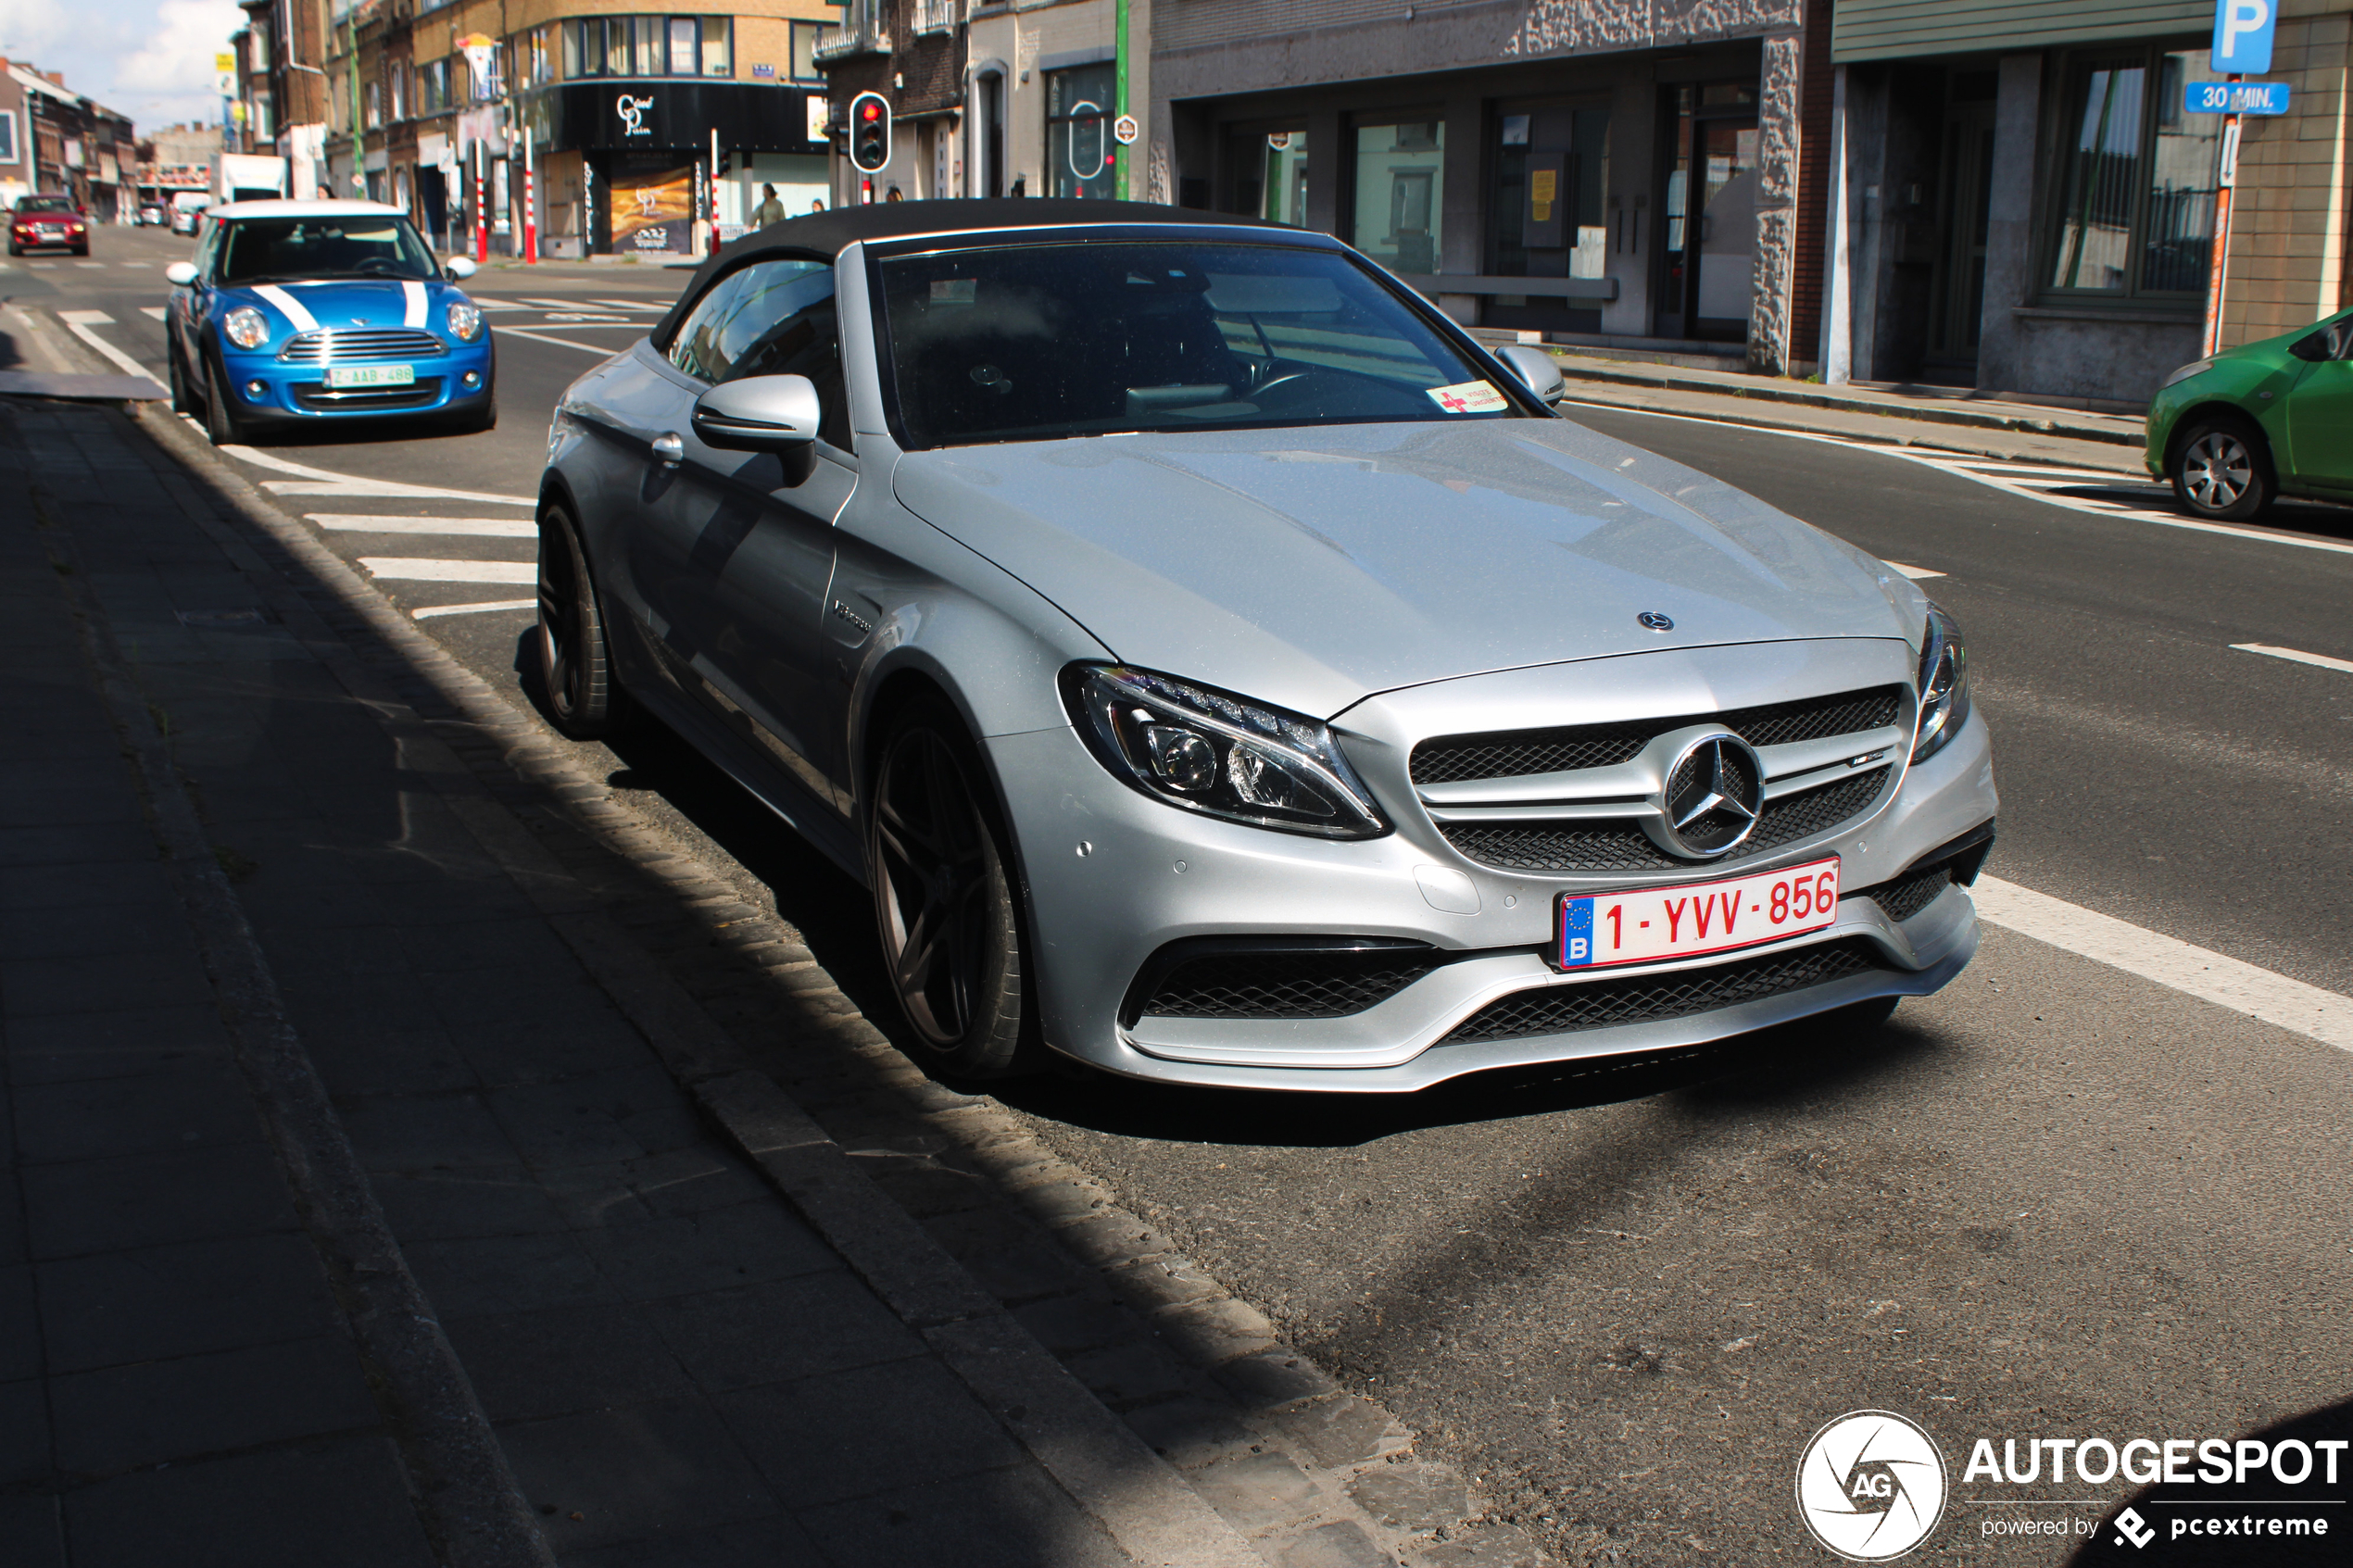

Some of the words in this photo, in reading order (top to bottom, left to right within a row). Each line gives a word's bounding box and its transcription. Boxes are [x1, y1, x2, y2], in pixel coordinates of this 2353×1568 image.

[2221, 0, 2269, 58] P
[2202, 86, 2228, 107] 30
[2233, 87, 2274, 108] MIN.
[333, 368, 412, 384] Z-AAB-488
[1465, 389, 1491, 398] VISITE
[1469, 396, 1505, 408] URGENTE
[1606, 872, 1835, 950] 1-YVV-856
[1570, 938, 1588, 960] B
